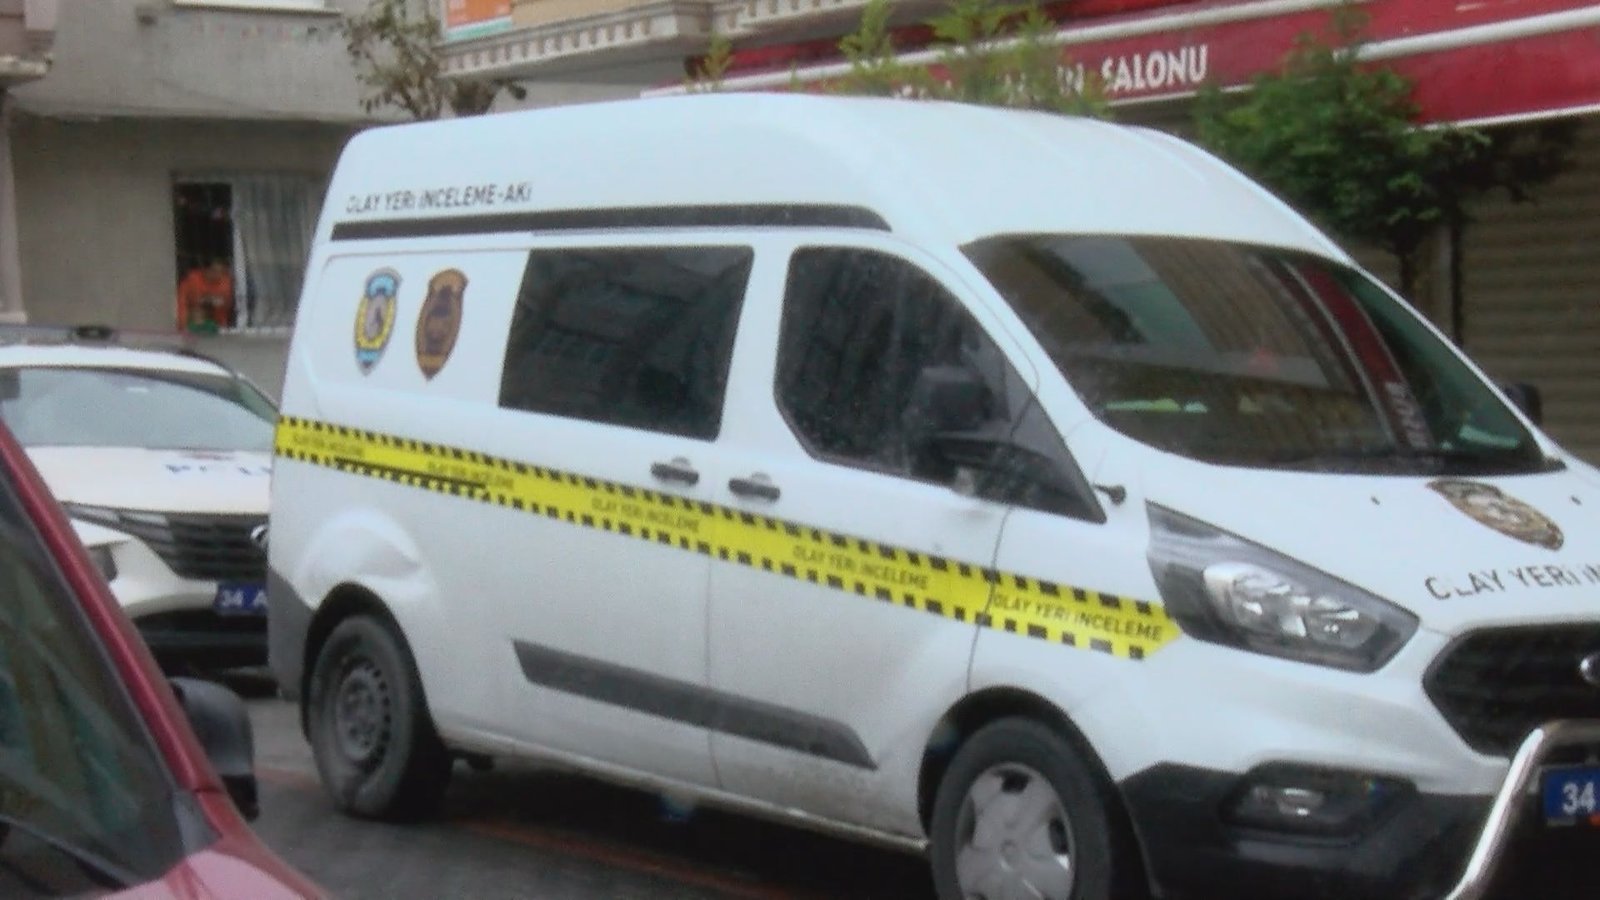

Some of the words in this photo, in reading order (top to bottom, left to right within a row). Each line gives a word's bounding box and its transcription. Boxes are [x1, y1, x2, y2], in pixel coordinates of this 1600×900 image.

[1101, 45, 1208, 92] SALONU
[793, 544, 825, 562] OLAY
[993, 594, 1032, 613] OLAY
[1563, 781, 1596, 815] 34
